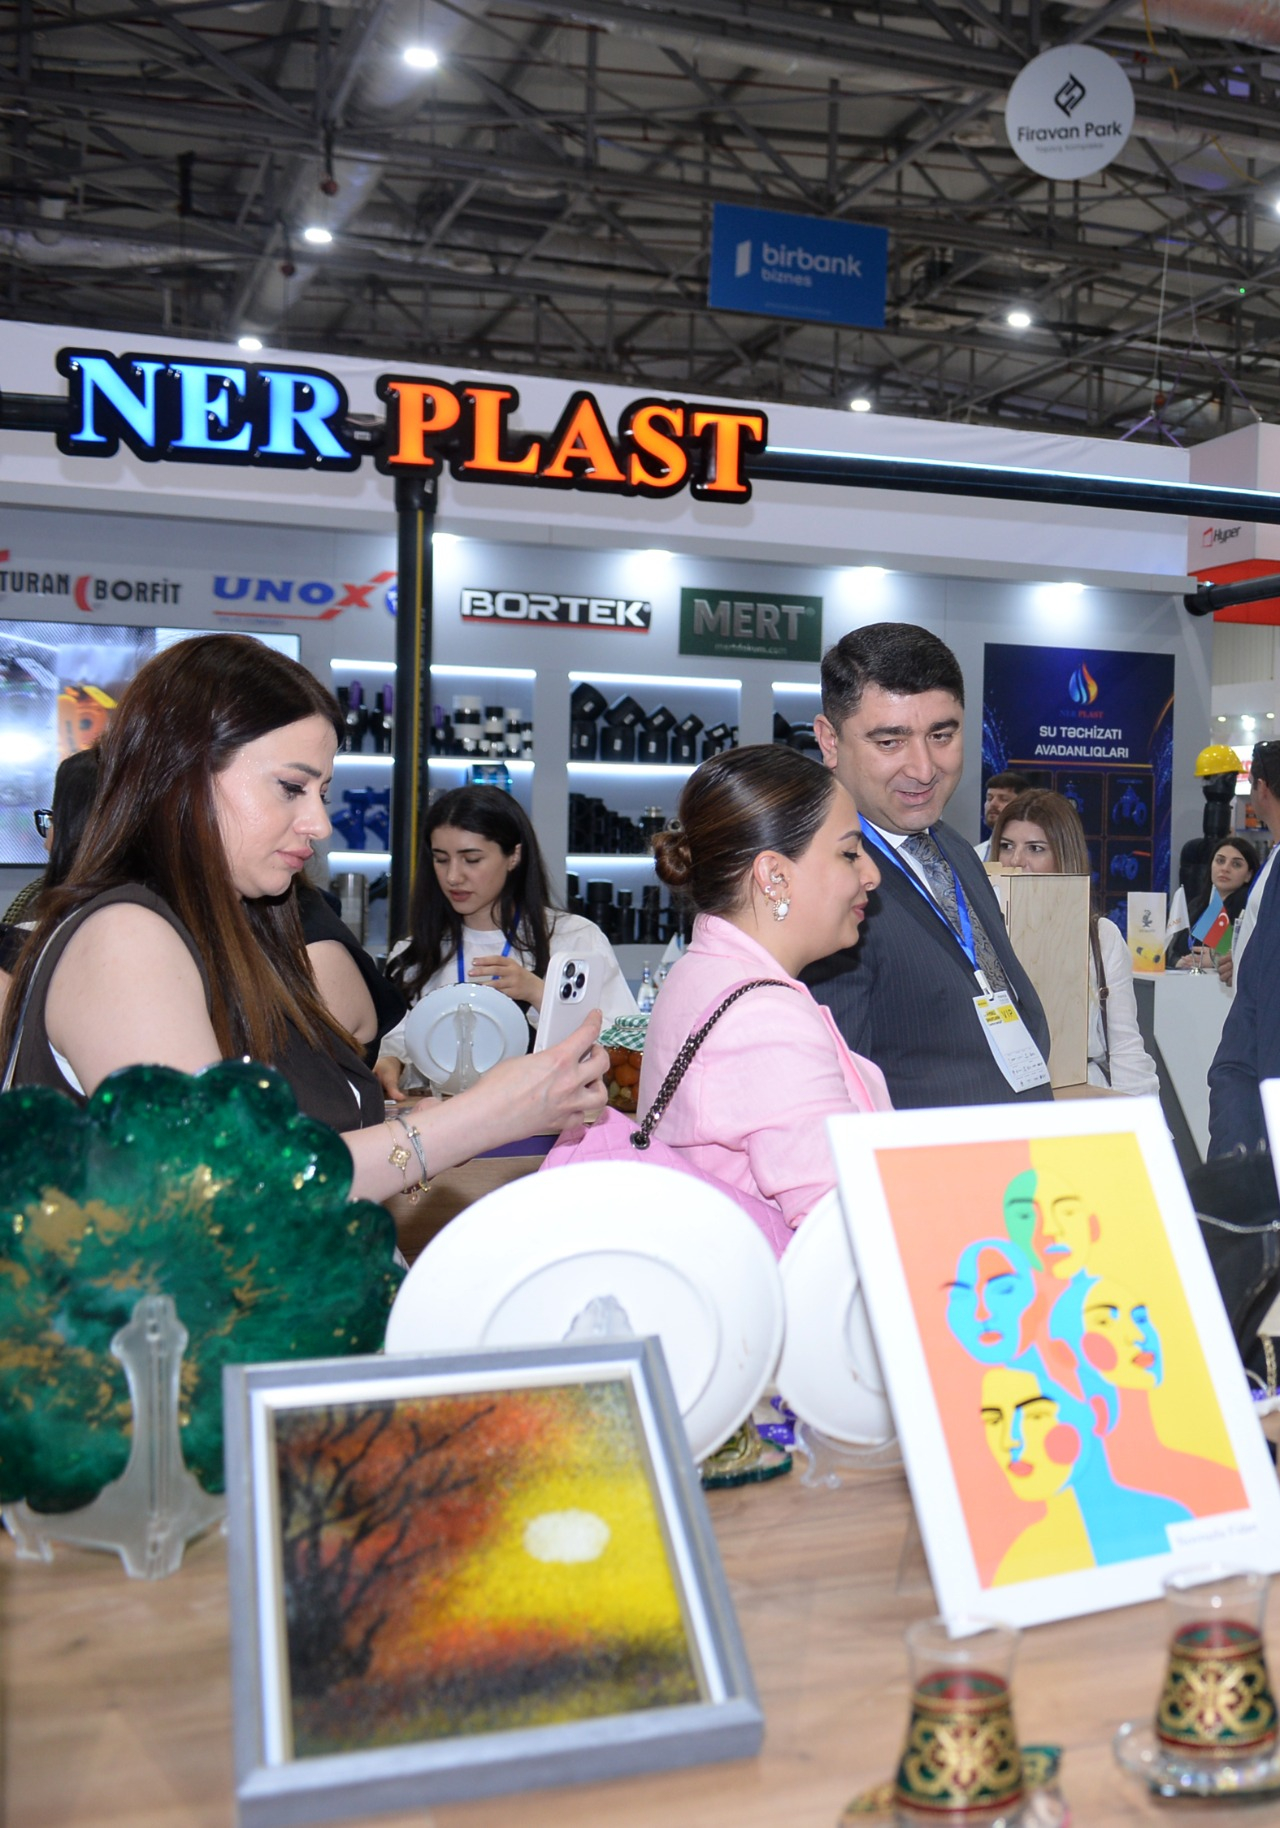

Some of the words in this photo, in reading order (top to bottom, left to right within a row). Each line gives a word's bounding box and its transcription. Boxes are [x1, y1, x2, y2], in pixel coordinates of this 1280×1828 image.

[1017, 125, 1079, 141] Firavan
[1084, 120, 1122, 137] Park
[762, 242, 862, 277] birbank
[761, 267, 813, 288] biznes
[70, 356, 351, 459] NER
[386, 381, 763, 493] PLAST
[1213, 526, 1242, 544] Hyper
[0, 570, 70, 595] TURAN
[213, 574, 374, 609] UNOX
[692, 598, 806, 641] MERT
[1039, 726, 1057, 738] SU
